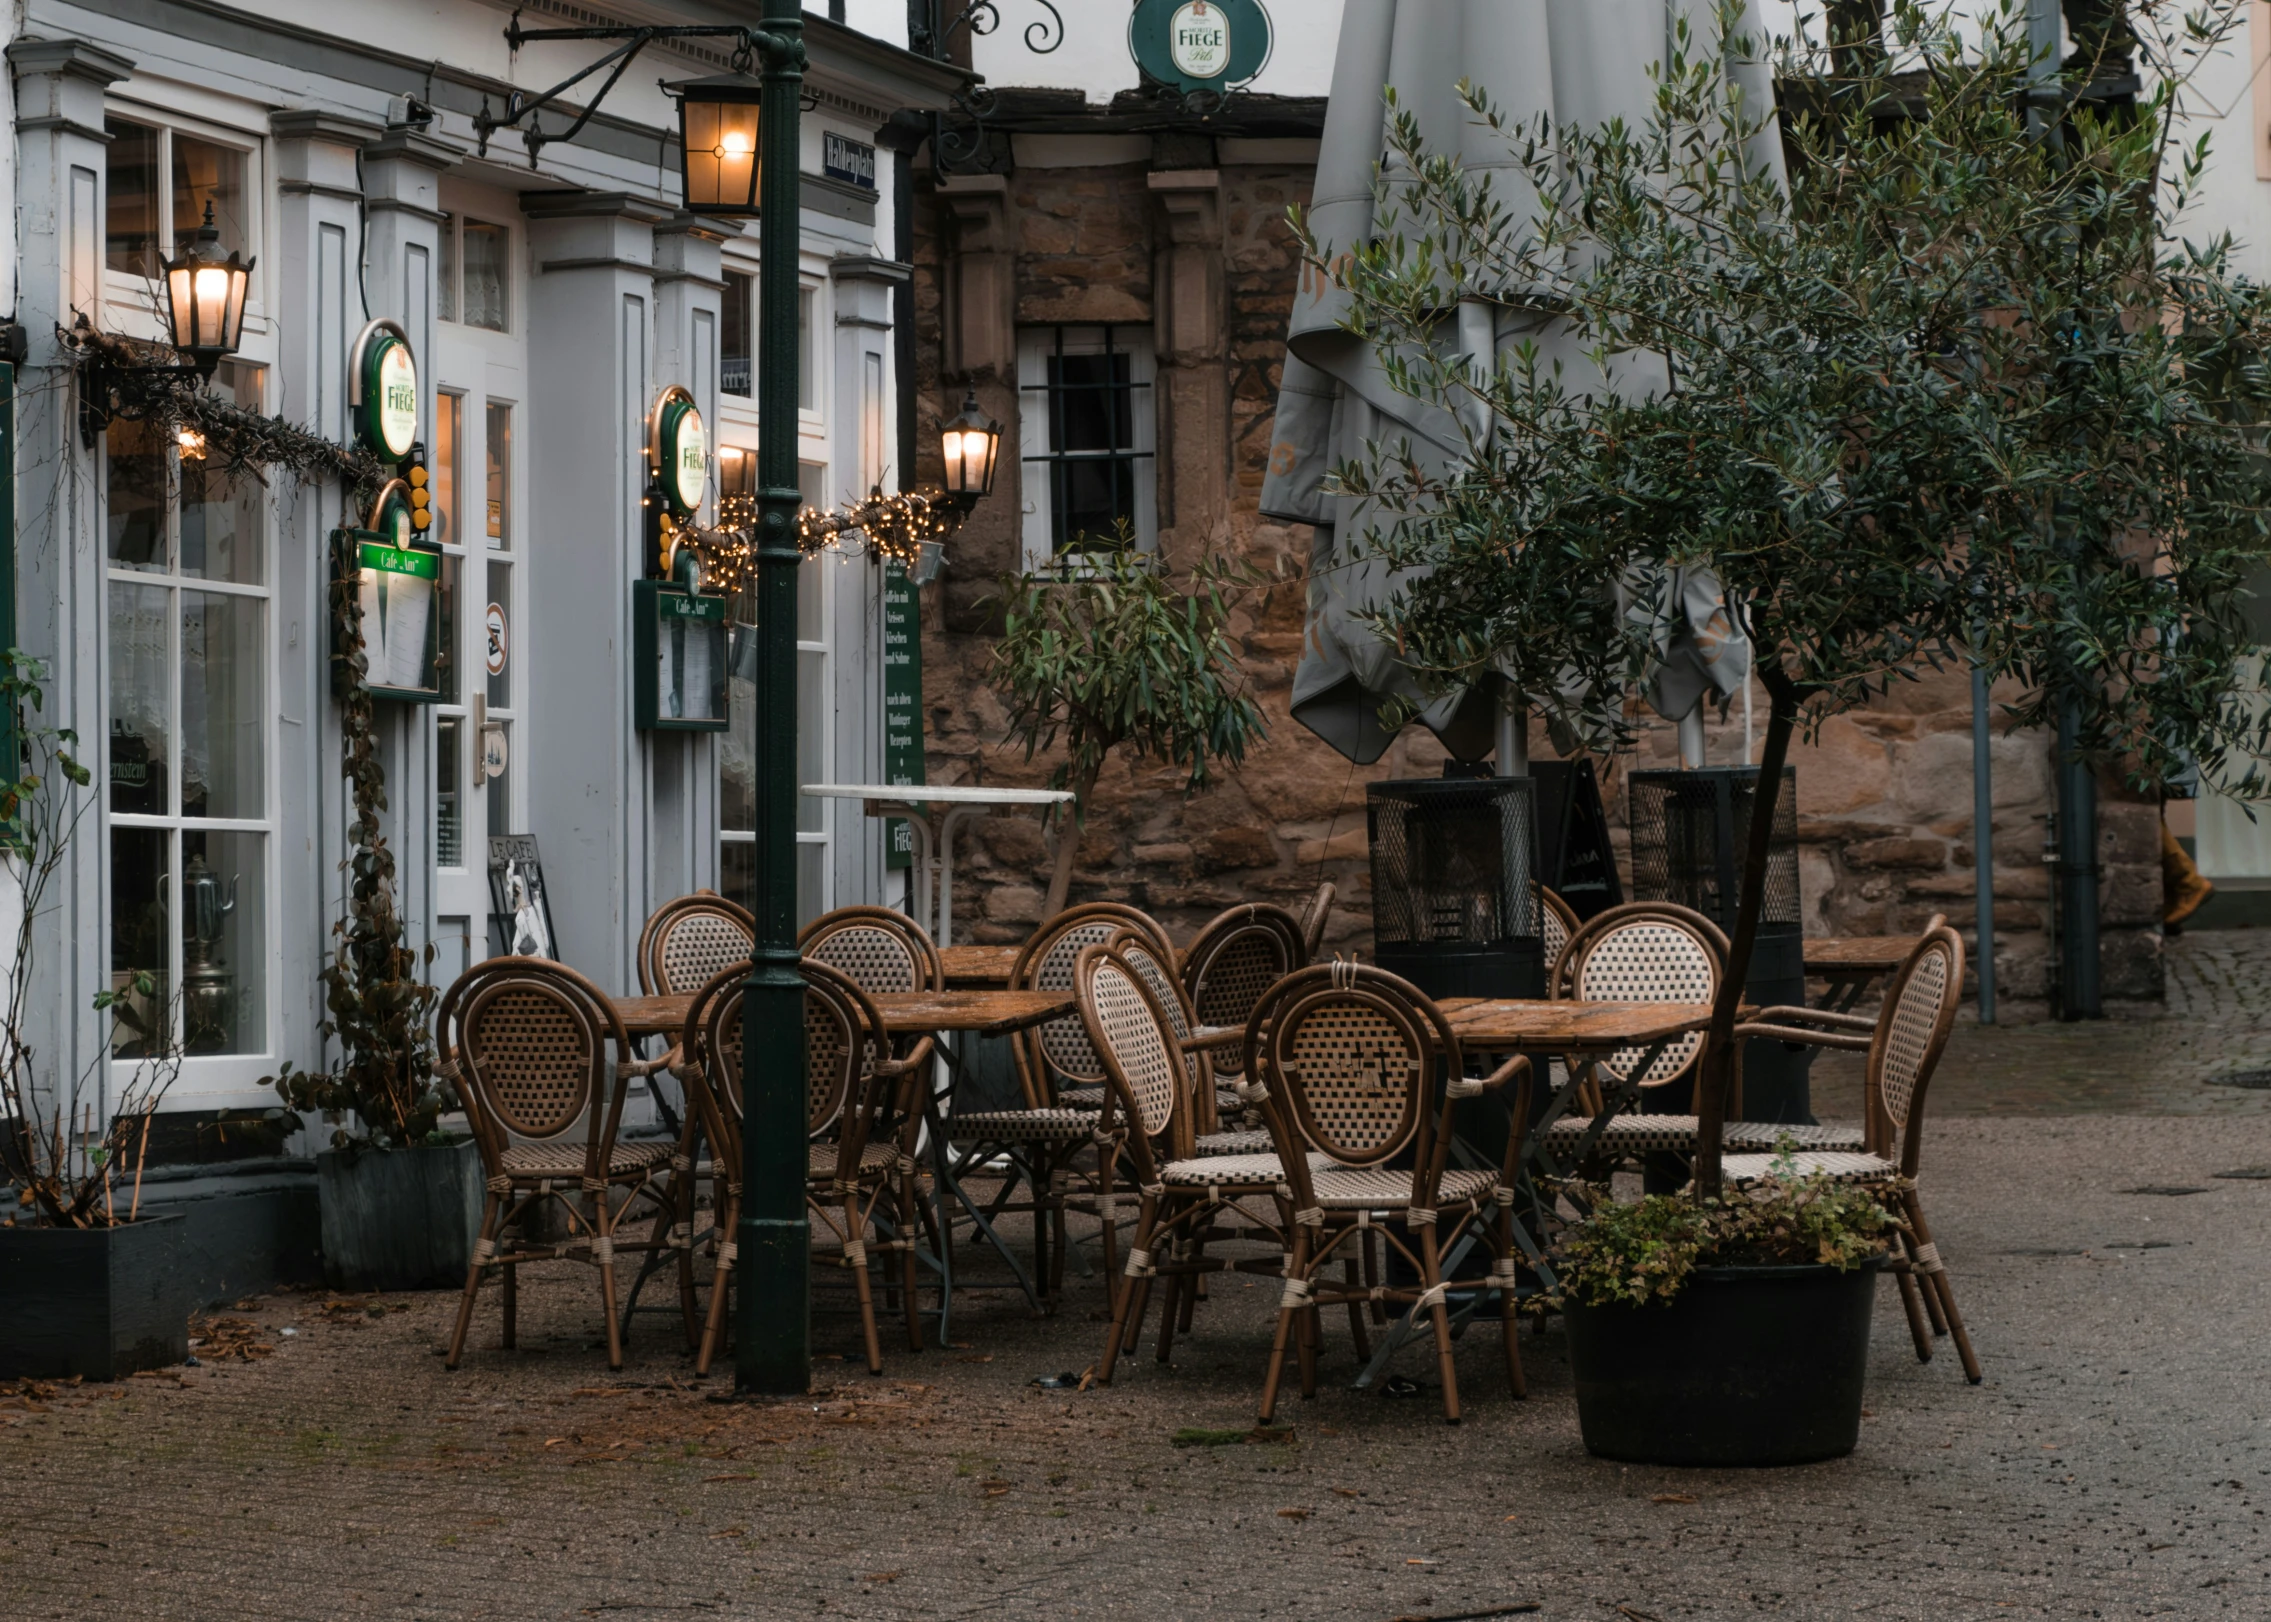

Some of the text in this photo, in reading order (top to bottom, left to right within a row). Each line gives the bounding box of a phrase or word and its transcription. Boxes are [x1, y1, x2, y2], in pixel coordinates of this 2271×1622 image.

[1179, 29, 1223, 46] FIEGE
[1187, 47, 1214, 61] Pils
[827, 136, 873, 183] Haldenplatz
[387, 385, 414, 412] FIEGE
[381, 551, 398, 569] Cafe
[676, 599, 691, 614] Cafe
[110, 760, 147, 779] ernstein
[893, 826, 912, 852] FIEG
[489, 839, 533, 860] LE CAFE
